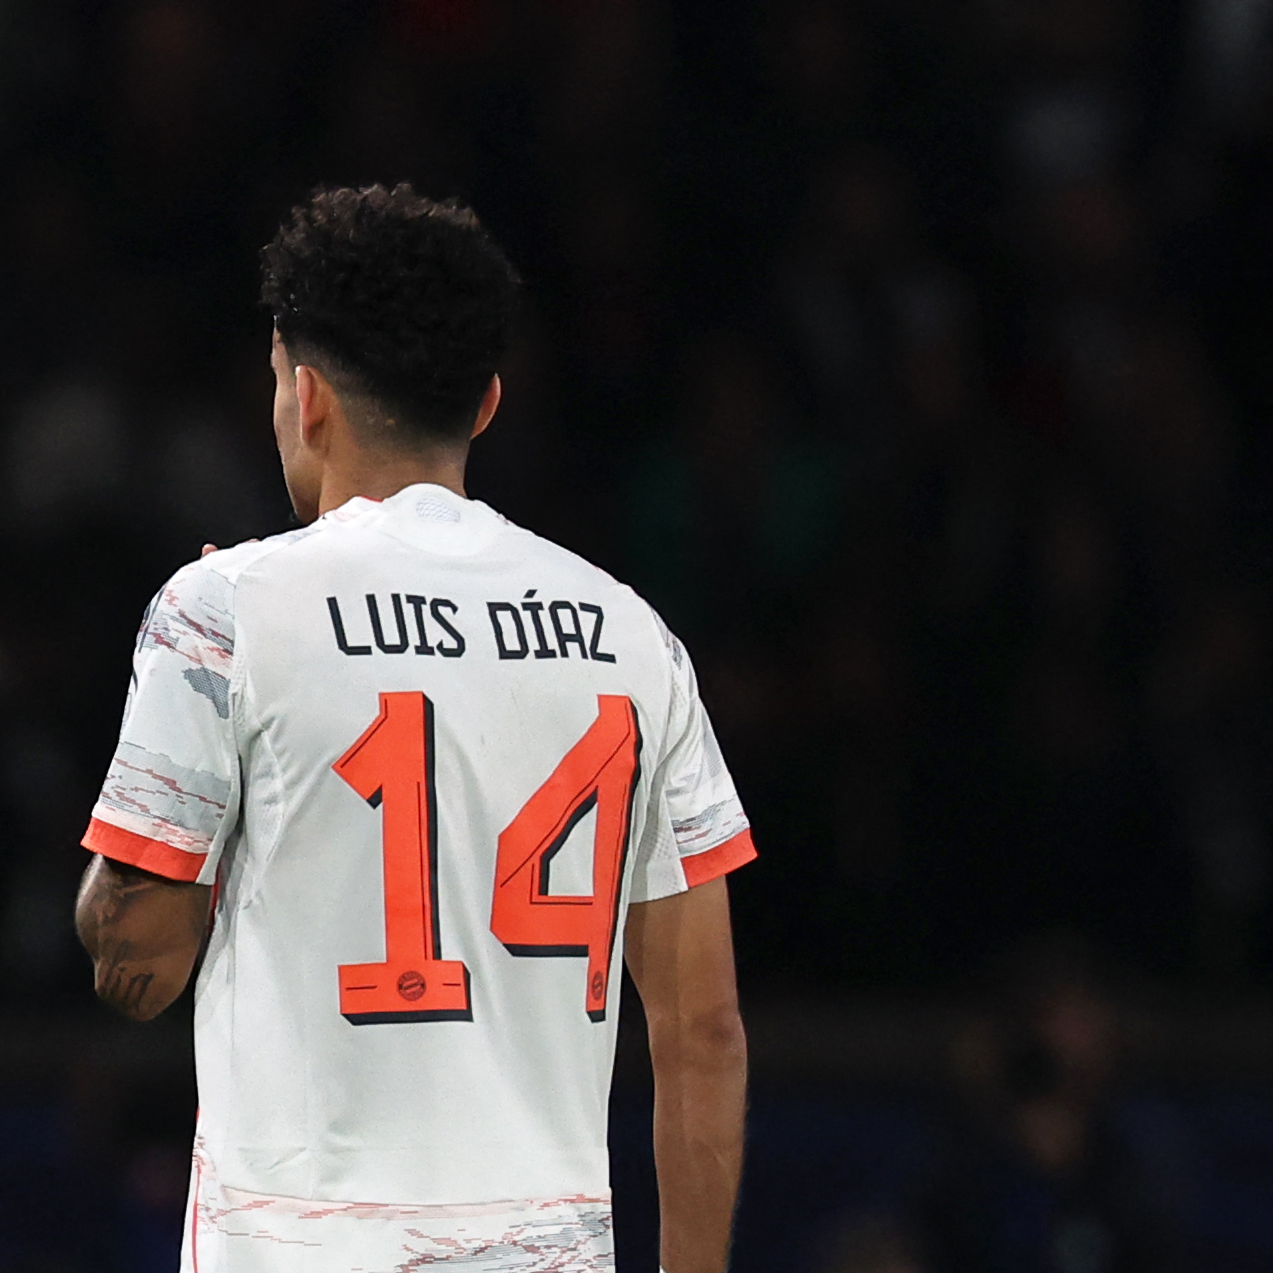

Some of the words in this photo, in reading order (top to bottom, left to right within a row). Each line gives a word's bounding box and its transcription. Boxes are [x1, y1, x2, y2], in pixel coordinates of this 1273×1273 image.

[326, 592, 466, 658] LUIS
[486, 588, 617, 664] DÍAZ
[330, 690, 644, 1026] 14
